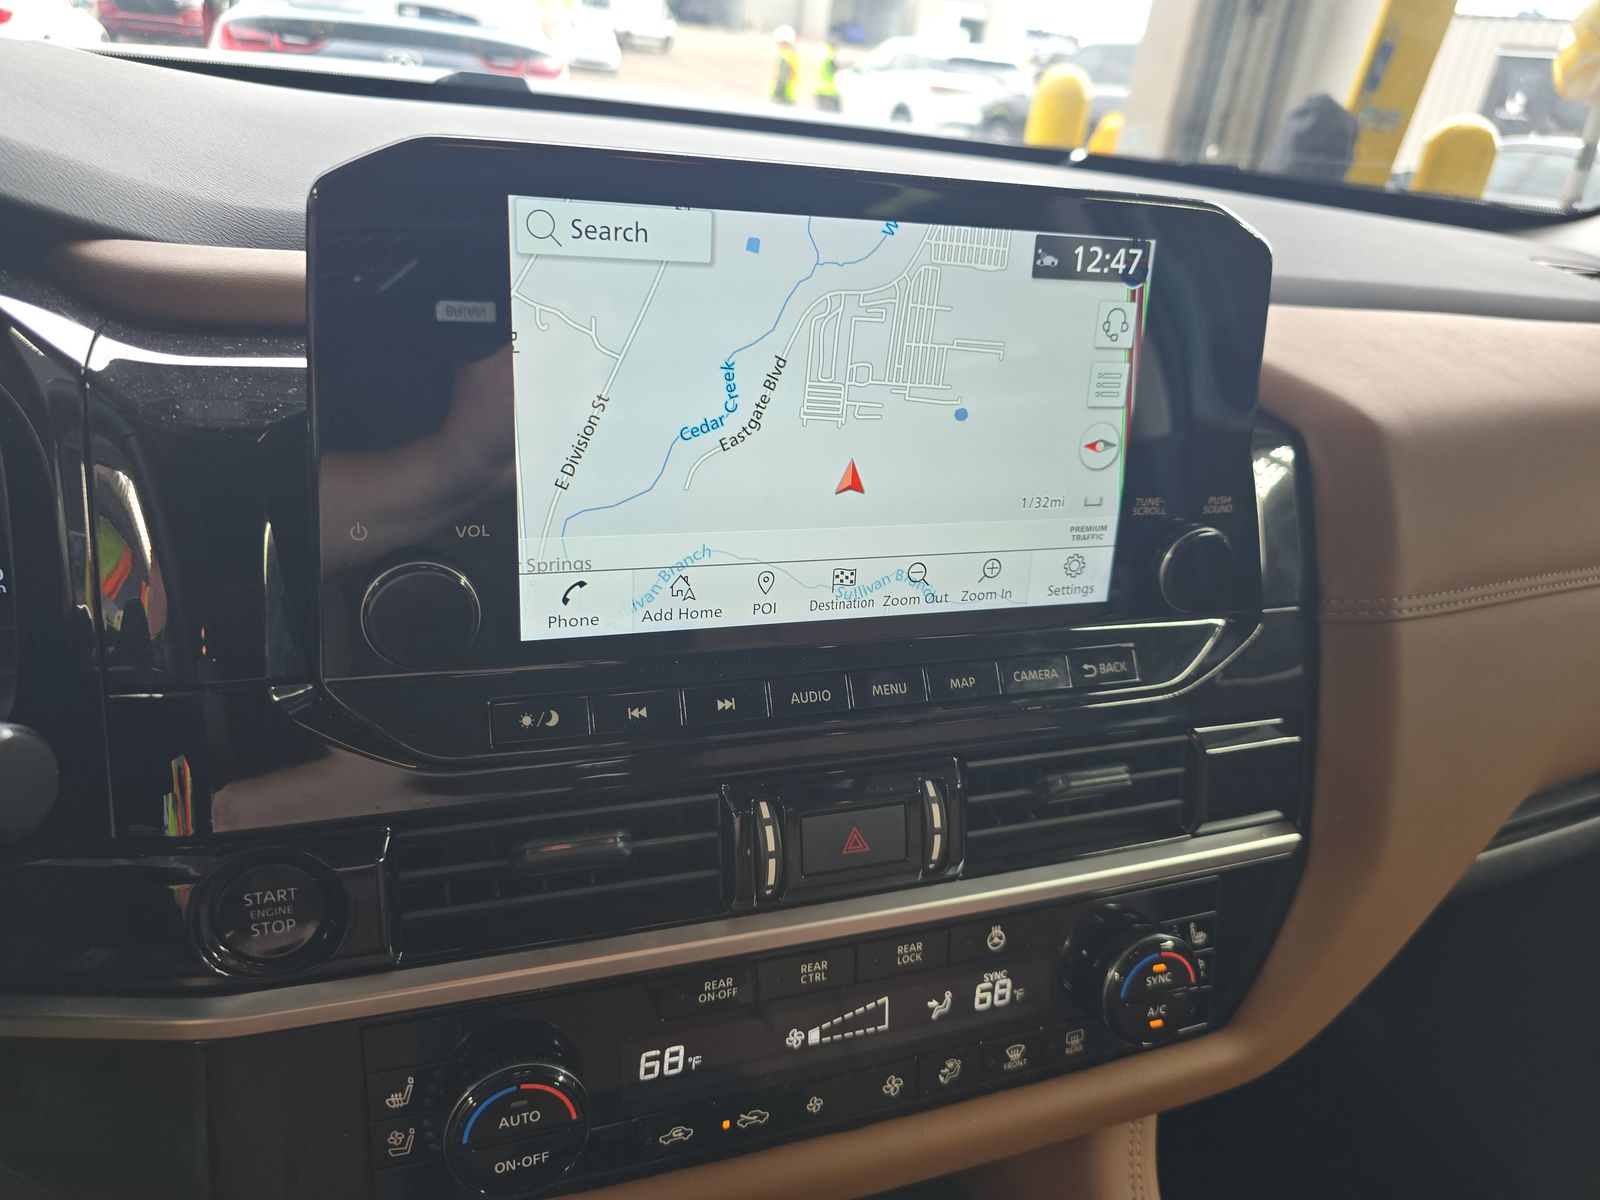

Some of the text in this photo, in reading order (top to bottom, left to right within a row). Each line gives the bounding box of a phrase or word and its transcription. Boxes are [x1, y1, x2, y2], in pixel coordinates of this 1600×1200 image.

[571, 218, 648, 243] Search
[1074, 245, 1143, 274] 12:47
[680, 360, 738, 441] Cedar Creek
[719, 355, 787, 452] Eastgate Blvd
[554, 393, 610, 491] E Division St
[1021, 495, 1065, 509] 1/32mi
[455, 525, 490, 538] VOL
[1070, 524, 1108, 533] PREMIUM
[1071, 533, 1104, 541] TRAFFIC
[658, 543, 712, 583] Branch
[834, 574, 891, 600] Sullivan
[961, 587, 1012, 602] Zoom In
[1047, 583, 1095, 597] Settings
[809, 596, 875, 612] Destination
[883, 591, 950, 608] Zoom Out
[641, 606, 723, 622] Add Home
[753, 602, 777, 615] POI
[548, 614, 600, 629] Phone
[1013, 668, 1059, 683] CAMERA
[1100, 661, 1127, 675] BACK
[872, 682, 907, 697] MENU
[950, 676, 976, 690] MAP
[791, 688, 831, 705] AUDIO
[243, 887, 298, 907] START
[250, 905, 294, 919] ENGINE
[251, 918, 296, 937] STOP
[897, 941, 923, 955] REAR
[897, 951, 923, 965] LOCK
[800, 960, 828, 974] REAR
[801, 971, 827, 984] CTRL
[983, 969, 1007, 982] SYNC
[1146, 972, 1172, 987] SYNC
[704, 977, 733, 991] REAR
[1147, 1005, 1167, 1017] A/C
[1003, 1058, 1027, 1071] FRONT
[499, 1110, 541, 1129] AUTO
